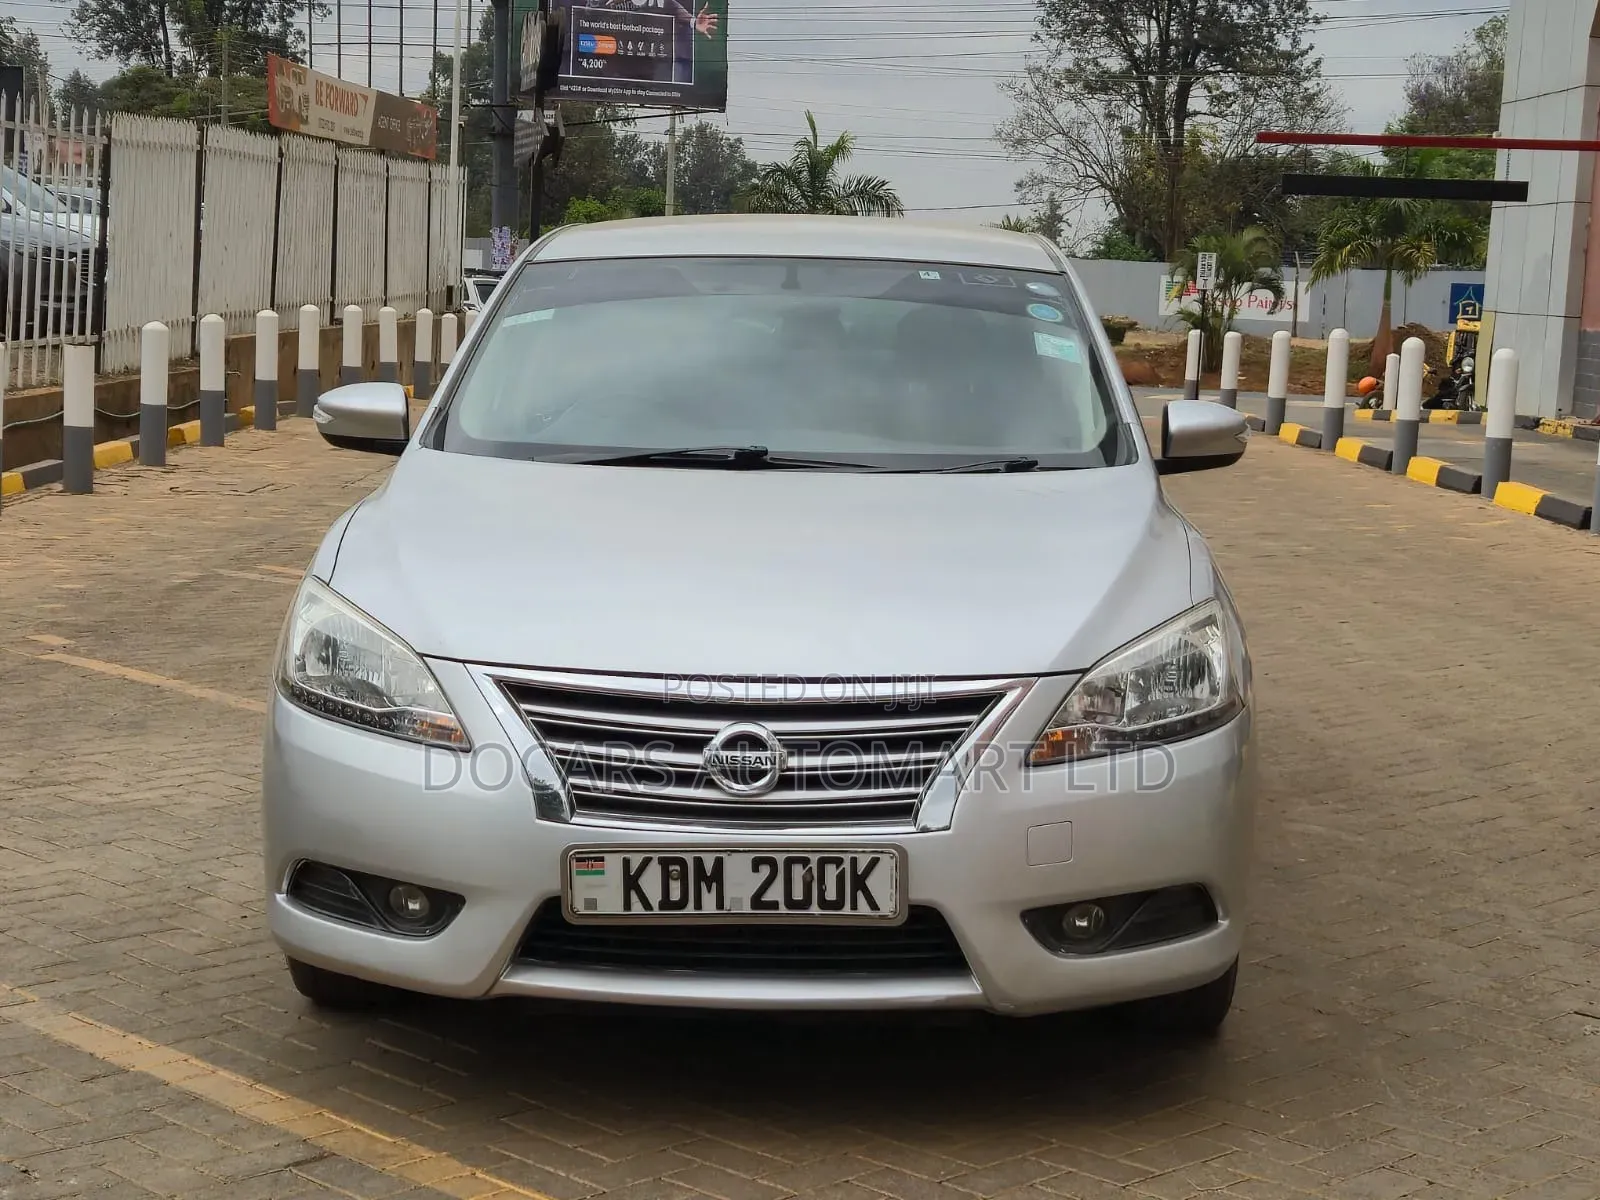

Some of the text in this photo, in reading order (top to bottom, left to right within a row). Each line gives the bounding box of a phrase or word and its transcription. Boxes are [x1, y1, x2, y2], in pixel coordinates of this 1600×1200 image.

[580, 19, 664, 35] The world's best football package
[315, 80, 359, 117] BE FORWARD
[711, 755, 777, 767] NISSAN
[622, 856, 881, 912] KDM 200K
